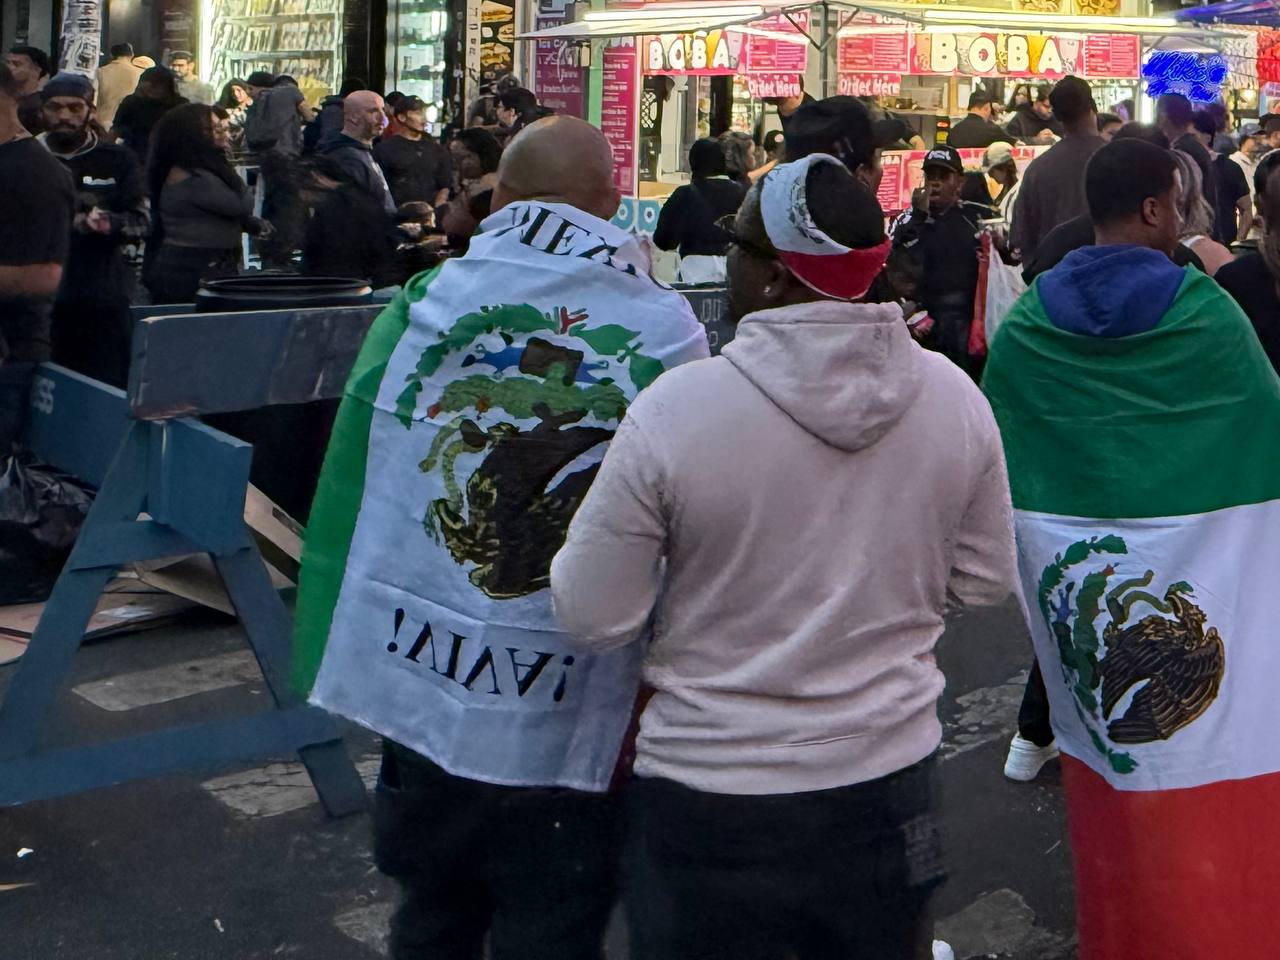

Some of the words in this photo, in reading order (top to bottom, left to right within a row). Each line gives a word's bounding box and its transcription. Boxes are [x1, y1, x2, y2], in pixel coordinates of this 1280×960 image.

[649, 36, 731, 71] BOBA
[931, 33, 1063, 74] BOBA
[749, 80, 776, 97] Order
[777, 80, 801, 96] Here
[840, 77, 873, 96] Order
[874, 77, 900, 95] Here
